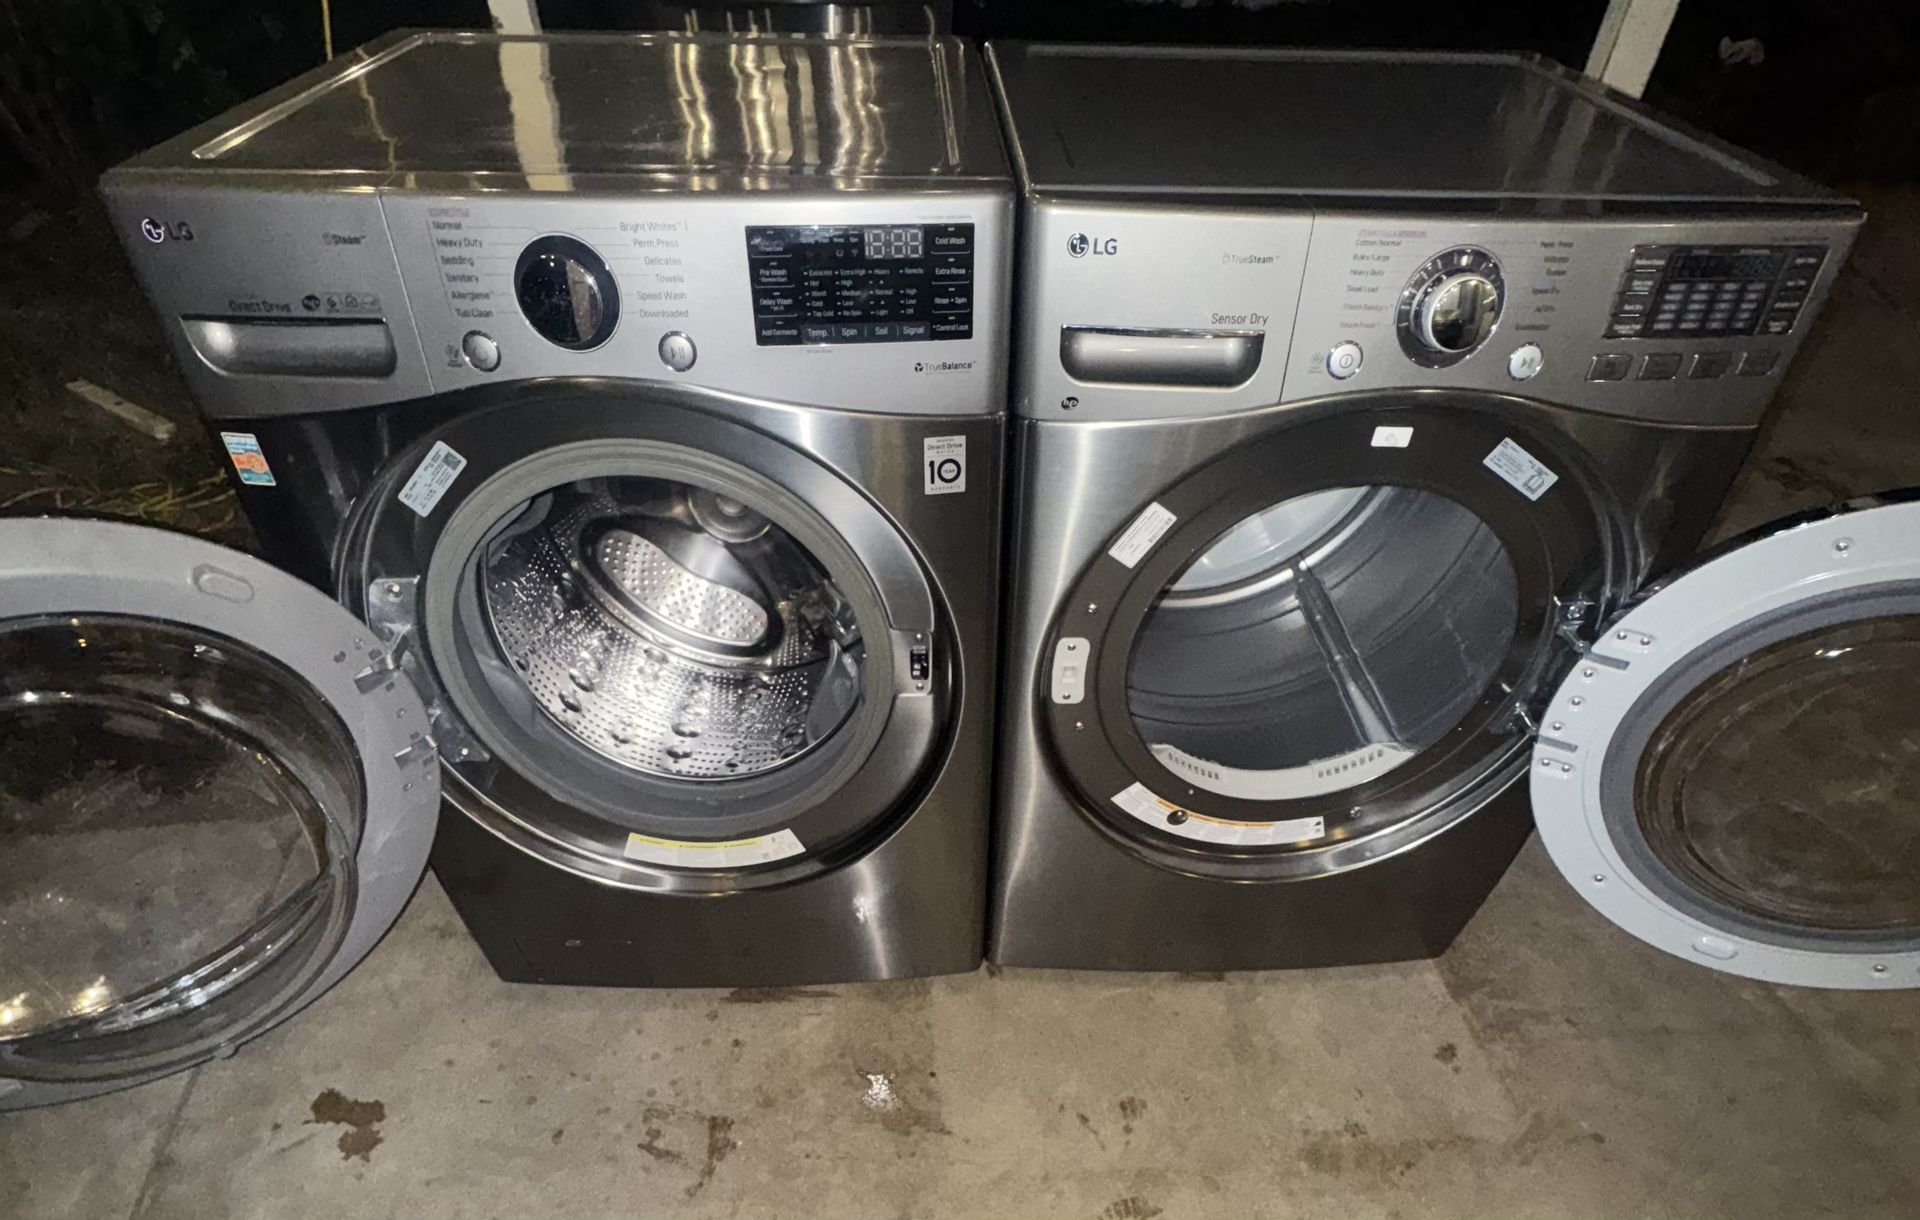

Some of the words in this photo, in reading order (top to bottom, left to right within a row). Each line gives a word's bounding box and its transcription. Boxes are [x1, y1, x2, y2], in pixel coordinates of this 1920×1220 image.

[432, 221, 462, 230] Normal
[619, 222, 646, 233] Bright
[167, 221, 194, 241] LG
[436, 238, 462, 248] Heavy
[463, 237, 483, 248] Duty
[935, 237, 949, 245] Cold
[950, 236, 966, 245] Wash
[1093, 238, 1118, 255] LG
[441, 256, 474, 267] Bedding
[644, 256, 682, 266] Delicates
[1231, 255, 1274, 264] TrueSteam
[446, 273, 479, 283] Sanitary
[656, 274, 684, 283] Towels
[637, 291, 662, 301] Speed
[664, 291, 687, 300] Wash
[955, 297, 967, 305] Spin
[228, 299, 262, 313] Direct
[262, 300, 292, 314] Drive
[456, 308, 471, 318] Tub
[471, 308, 493, 318] Clean
[640, 309, 689, 318] Downloaded
[1211, 313, 1247, 325] Sensor
[1249, 314, 1269, 327] Dry
[808, 328, 828, 337] Temp.
[842, 328, 857, 337] Spin
[875, 326, 888, 335] Soil
[903, 325, 925, 336] Signal
[929, 458, 962, 484] 10
